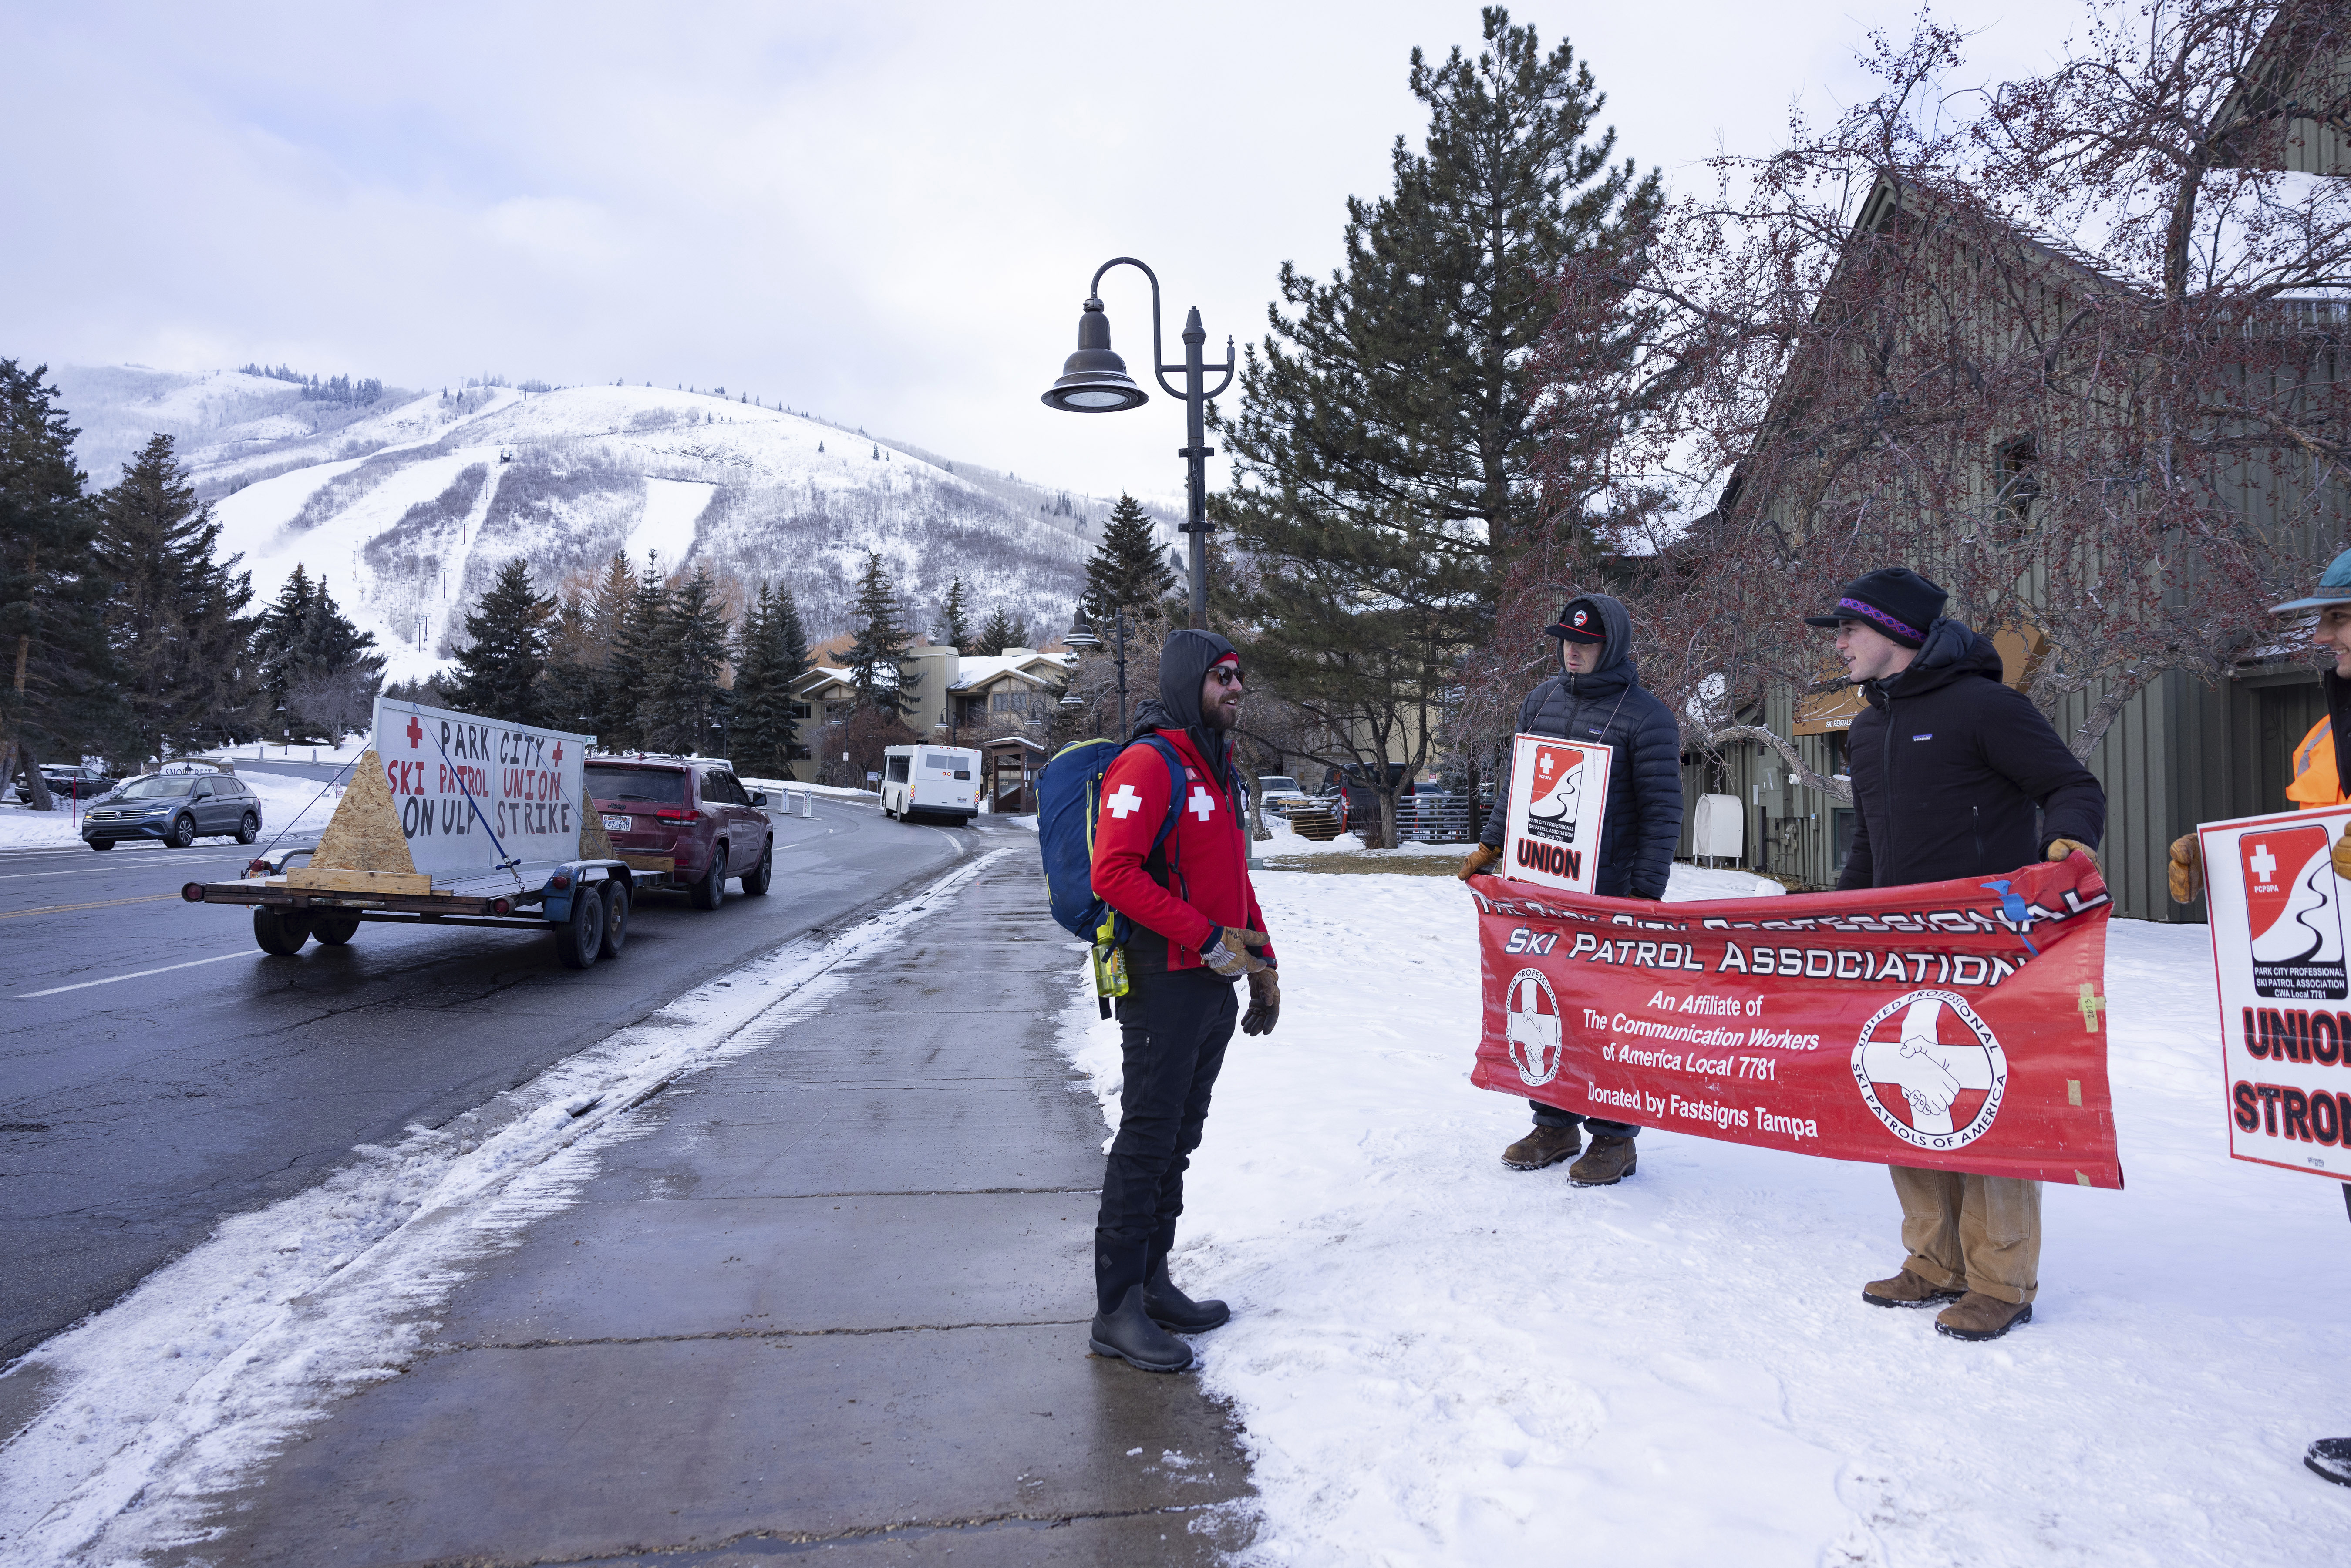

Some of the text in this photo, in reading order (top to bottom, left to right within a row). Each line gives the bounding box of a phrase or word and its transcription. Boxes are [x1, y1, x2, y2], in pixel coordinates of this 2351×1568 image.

[441, 721, 545, 768] PARK CITY
[387, 760, 561, 802] SKI PATROL UNION
[403, 796, 570, 839] ON ULP STRIKE
[1547, 821, 1574, 831] PROFESSIONAL
[1549, 828, 1573, 838] ASSOCIATION
[1517, 838, 1581, 881] UNION
[2254, 885, 2279, 893] PCPSPA
[1505, 927, 2032, 987] SKI PATROL ASSOCIATION
[2255, 967, 2345, 977] PARK CITY PROFESSIONAL
[1507, 969, 1560, 1021] UNITED PROFESSIONAL
[1647, 990, 1764, 1016] An Affiliate of
[2257, 978, 2345, 989] SKI PATROL ASSOCIATION
[2274, 989, 2326, 999] CWA Local 7781
[1583, 1009, 1819, 1050] The Communication Workers
[1858, 990, 1998, 1053] UNITED PROFESSIONAL
[1510, 1050, 1531, 1083] PATROLS
[1544, 1038, 1561, 1082] AMERICA
[1603, 1042, 1776, 1080] of America Local 7781
[1588, 1081, 1819, 1141] Donated by Fastsigns Tampa
[1853, 1063, 2006, 1147] SKI PATROLS OF AMERICA
